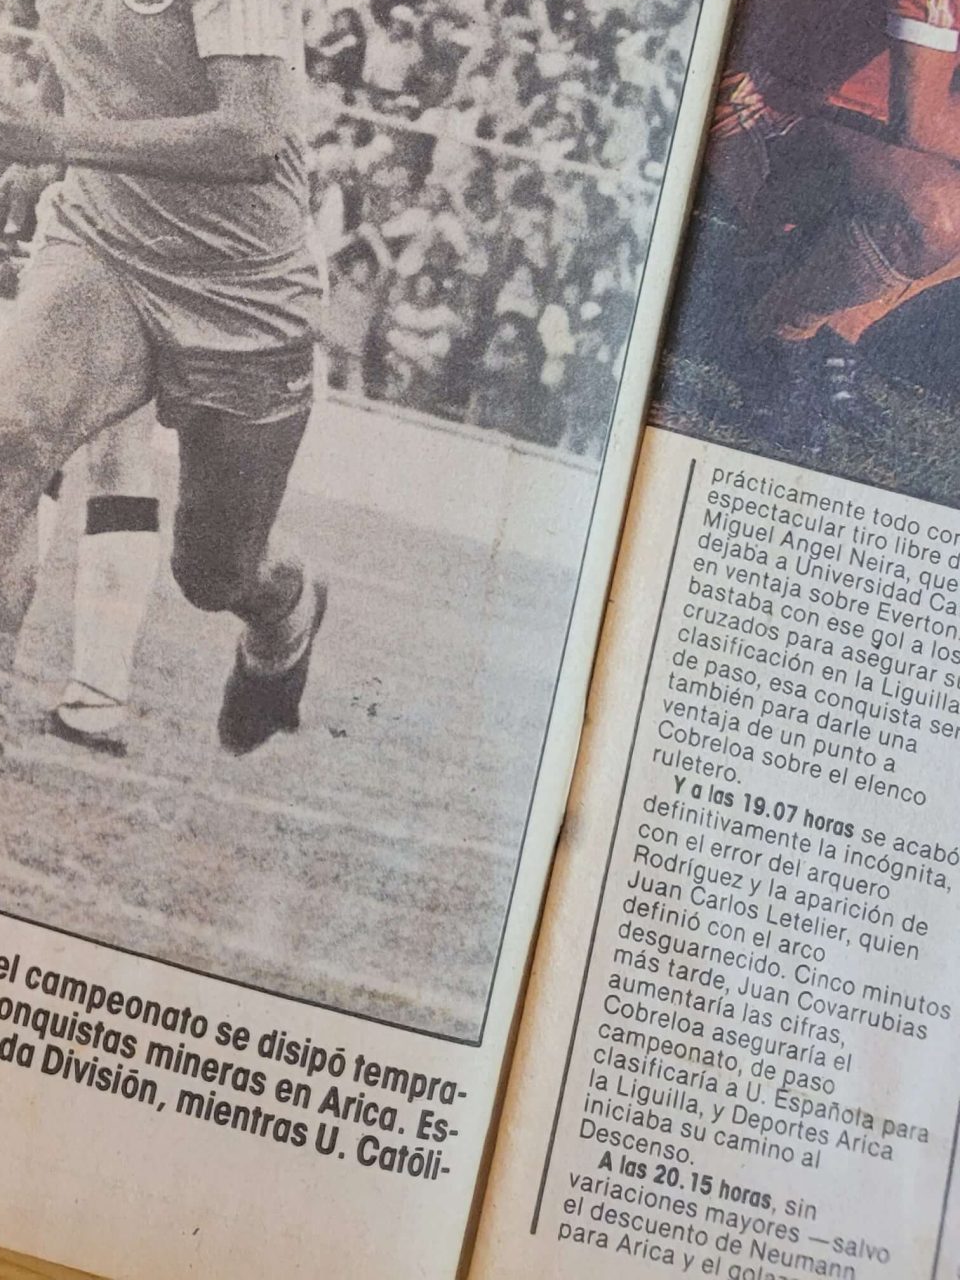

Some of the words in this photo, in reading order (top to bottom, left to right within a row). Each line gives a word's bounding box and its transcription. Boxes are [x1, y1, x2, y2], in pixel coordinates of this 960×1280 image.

[703, 507, 775, 548] Miguel
[780, 530, 843, 565] Angel
[848, 547, 910, 585] Neira,
[658, 719, 755, 762] Cobreloa
[761, 750, 823, 779] sobre
[828, 767, 849, 786] el
[854, 773, 927, 806] elenco
[673, 774, 687, 795] Y
[690, 783, 703, 800] a
[707, 783, 735, 808] las
[802, 808, 855, 839] horas
[861, 828, 887, 847] se
[627, 870, 682, 901] Juan
[690, 885, 759, 920] Carlos
[766, 903, 851, 947] Letelier,
[858, 932, 919, 961] quien
[24, 965, 209, 1050] campeonato
[214, 1021, 251, 1052] se
[257, 1029, 347, 1078] disipó
[352, 1054, 468, 1106] tempra-
[40, 1043, 167, 1113] División,
[175, 1088, 309, 1148] mientras
[314, 1122, 345, 1160] U.
[356, 1134, 451, 1181] Católi-
[144, 1040, 267, 1097] mineras
[274, 1078, 312, 1110] en
[317, 1085, 405, 1135] Arica.
[414, 1109, 459, 1156] Es-
[597, 1150, 613, 1172] A
[618, 1154, 648, 1180] las
[718, 1178, 776, 1215] horas,
[784, 1199, 817, 1221] sin
